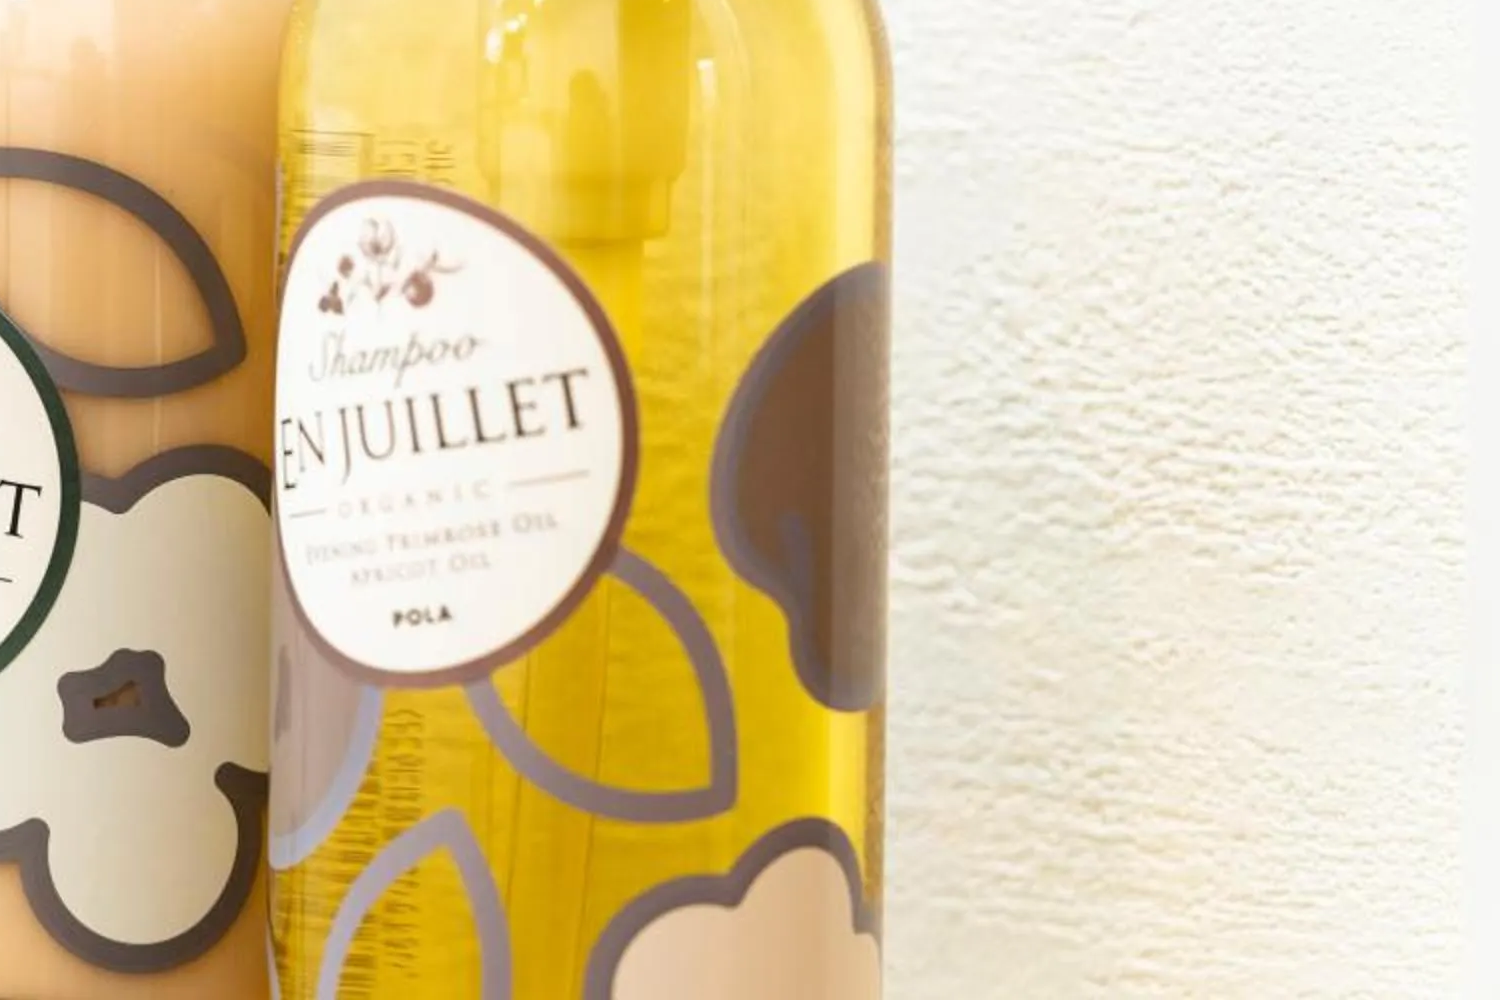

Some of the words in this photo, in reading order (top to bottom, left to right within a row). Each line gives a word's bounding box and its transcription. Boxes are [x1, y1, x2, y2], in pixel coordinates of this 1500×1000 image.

[308, 329, 488, 389] Shampoo
[280, 408, 327, 491] EN
[338, 369, 589, 485] JUILLET
[392, 604, 453, 629] POLA
